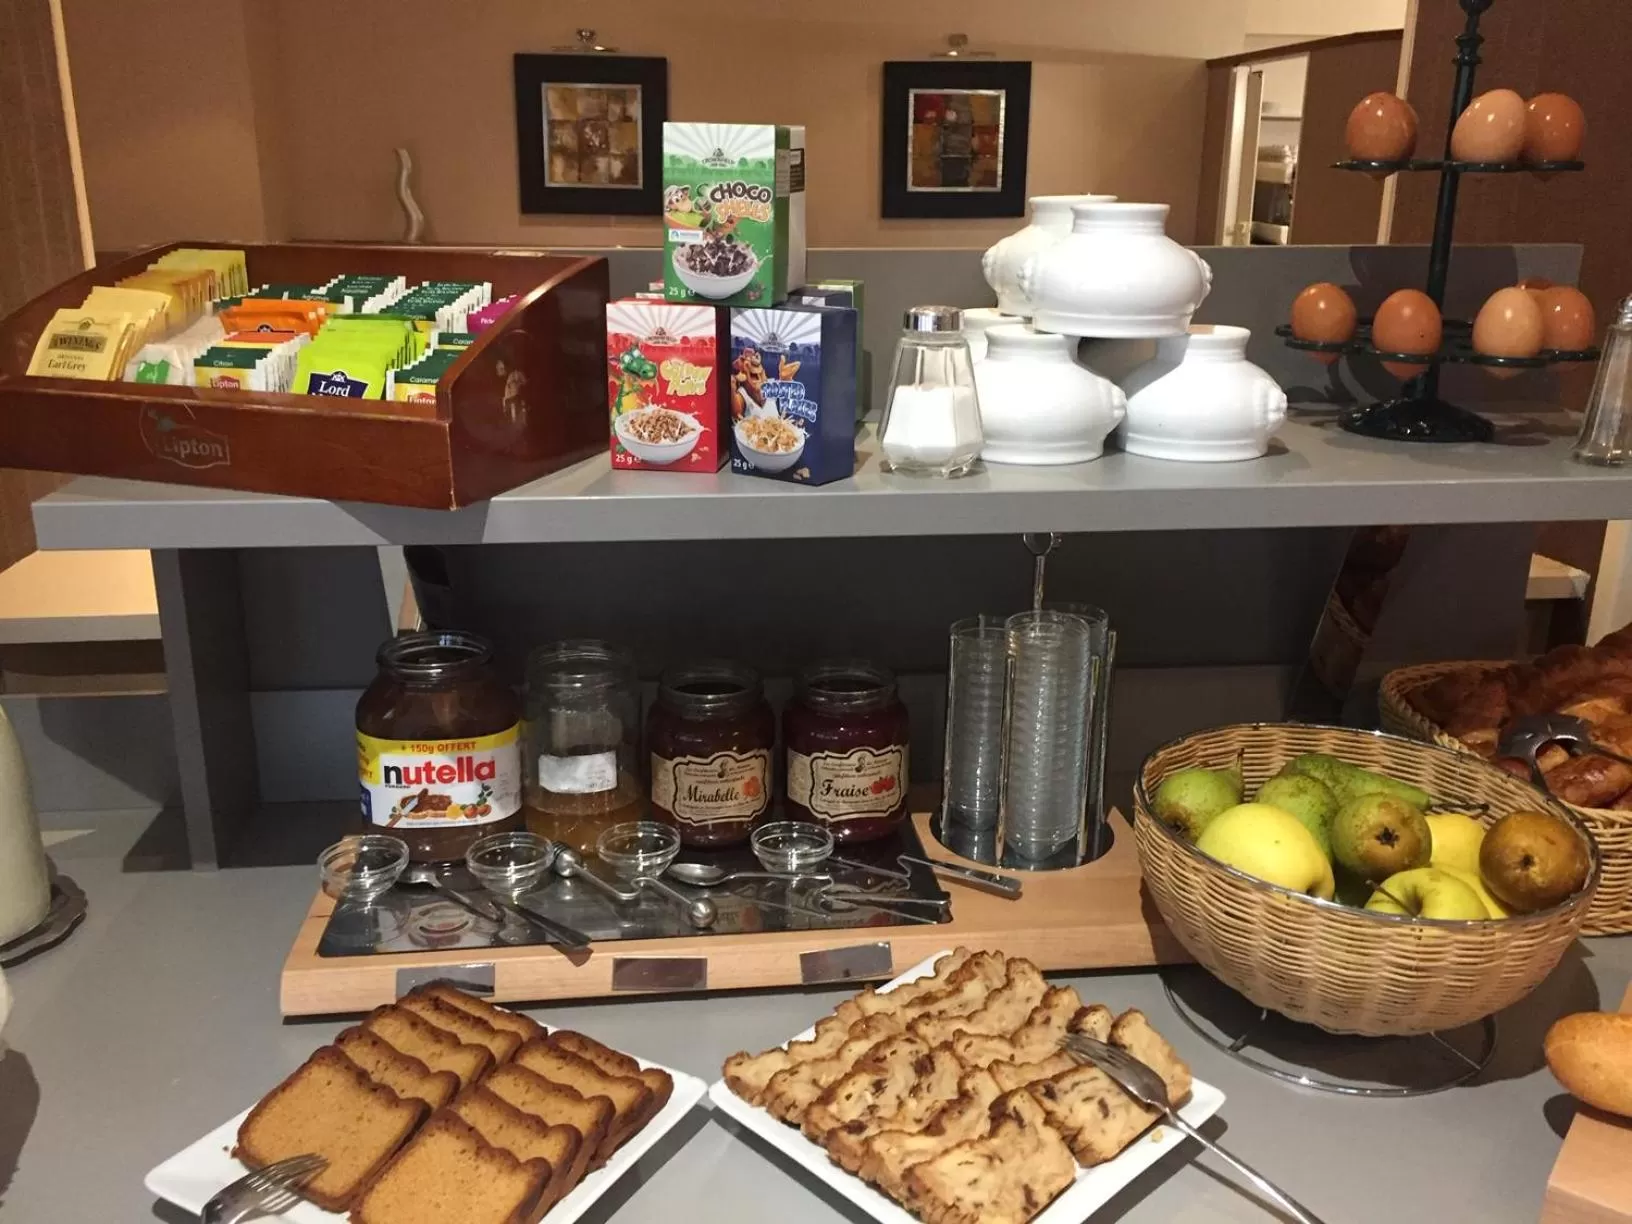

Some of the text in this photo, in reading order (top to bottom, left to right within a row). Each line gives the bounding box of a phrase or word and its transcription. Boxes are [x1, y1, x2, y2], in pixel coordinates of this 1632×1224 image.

[710, 181, 772, 203] CHOCO
[48, 359, 88, 372] Earl Grey
[212, 378, 239, 389] Lipton
[319, 381, 351, 397] Lord
[162, 436, 225, 458] Lipton
[615, 454, 625, 463] 25
[733, 459, 742, 468] 25
[410, 743, 435, 754] 150g
[437, 741, 476, 752] OFFERT
[384, 756, 496, 785] nutella
[683, 784, 740, 803] Mirabelle
[820, 779, 870, 798] Fraise
